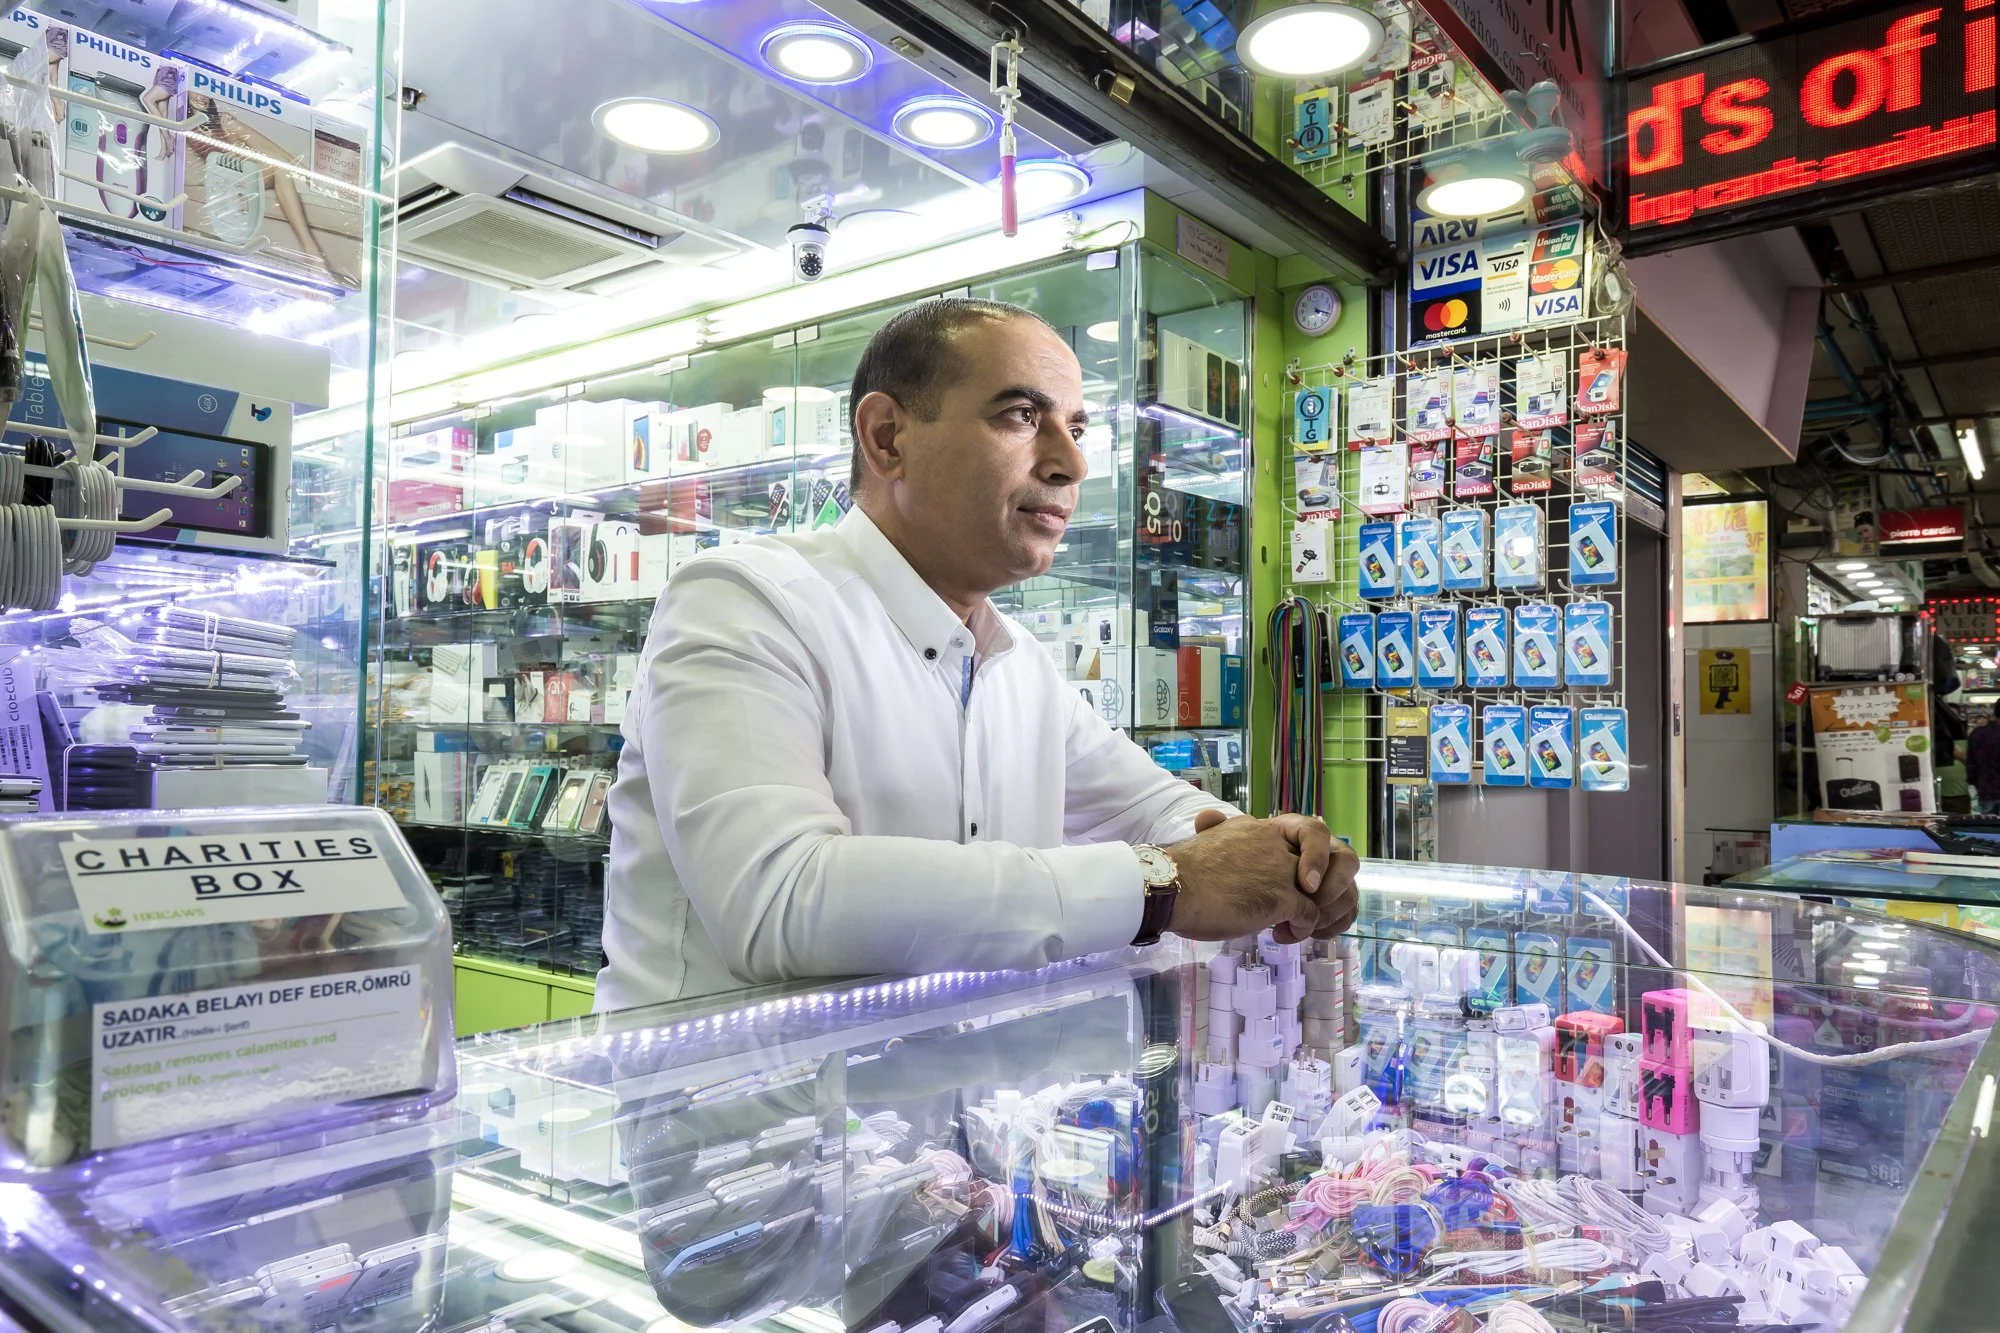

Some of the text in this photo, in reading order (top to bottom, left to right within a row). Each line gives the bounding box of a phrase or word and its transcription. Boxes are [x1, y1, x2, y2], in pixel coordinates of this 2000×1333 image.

[8, 10, 39, 29] PS
[76, 31, 151, 69] PHILIPS
[1800, 9, 1943, 128] of
[193, 72, 282, 115] PHILIPS
[320, 153, 357, 171] smooth
[1537, 232, 1576, 247] UnionPay
[1417, 250, 1479, 281] VISA
[1492, 258, 1520, 273] VISA
[1532, 269, 1579, 285] MasterCard
[1535, 295, 1579, 316] VISA
[1425, 326, 1468, 340] mastercard
[1580, 402, 1618, 412] SanDisk
[1300, 394, 1325, 440] OTG
[1519, 416, 1563, 428] SanDisk
[1409, 430, 1449, 443] SanDisk
[1455, 426, 1496, 439] SanDisk
[1456, 485, 1491, 497] SanDisk
[1513, 482, 1550, 491] SanDisk
[1304, 511, 1338, 520] anDisk
[1890, 526, 1956, 538] pierre cardin
[1938, 603, 1993, 616] PURE
[1153, 625, 1174, 635] Galaxy
[1944, 616, 1988, 629] VEG
[74, 837, 373, 870] CHARITIES
[191, 869, 303, 895] BOX
[102, 970, 411, 1026] SADAKA BELAYI DEF EDER,ÖMRÜ
[166, 1050, 231, 1068] removes
[236, 1037, 308, 1058] calamities
[311, 1032, 337, 1046] and
